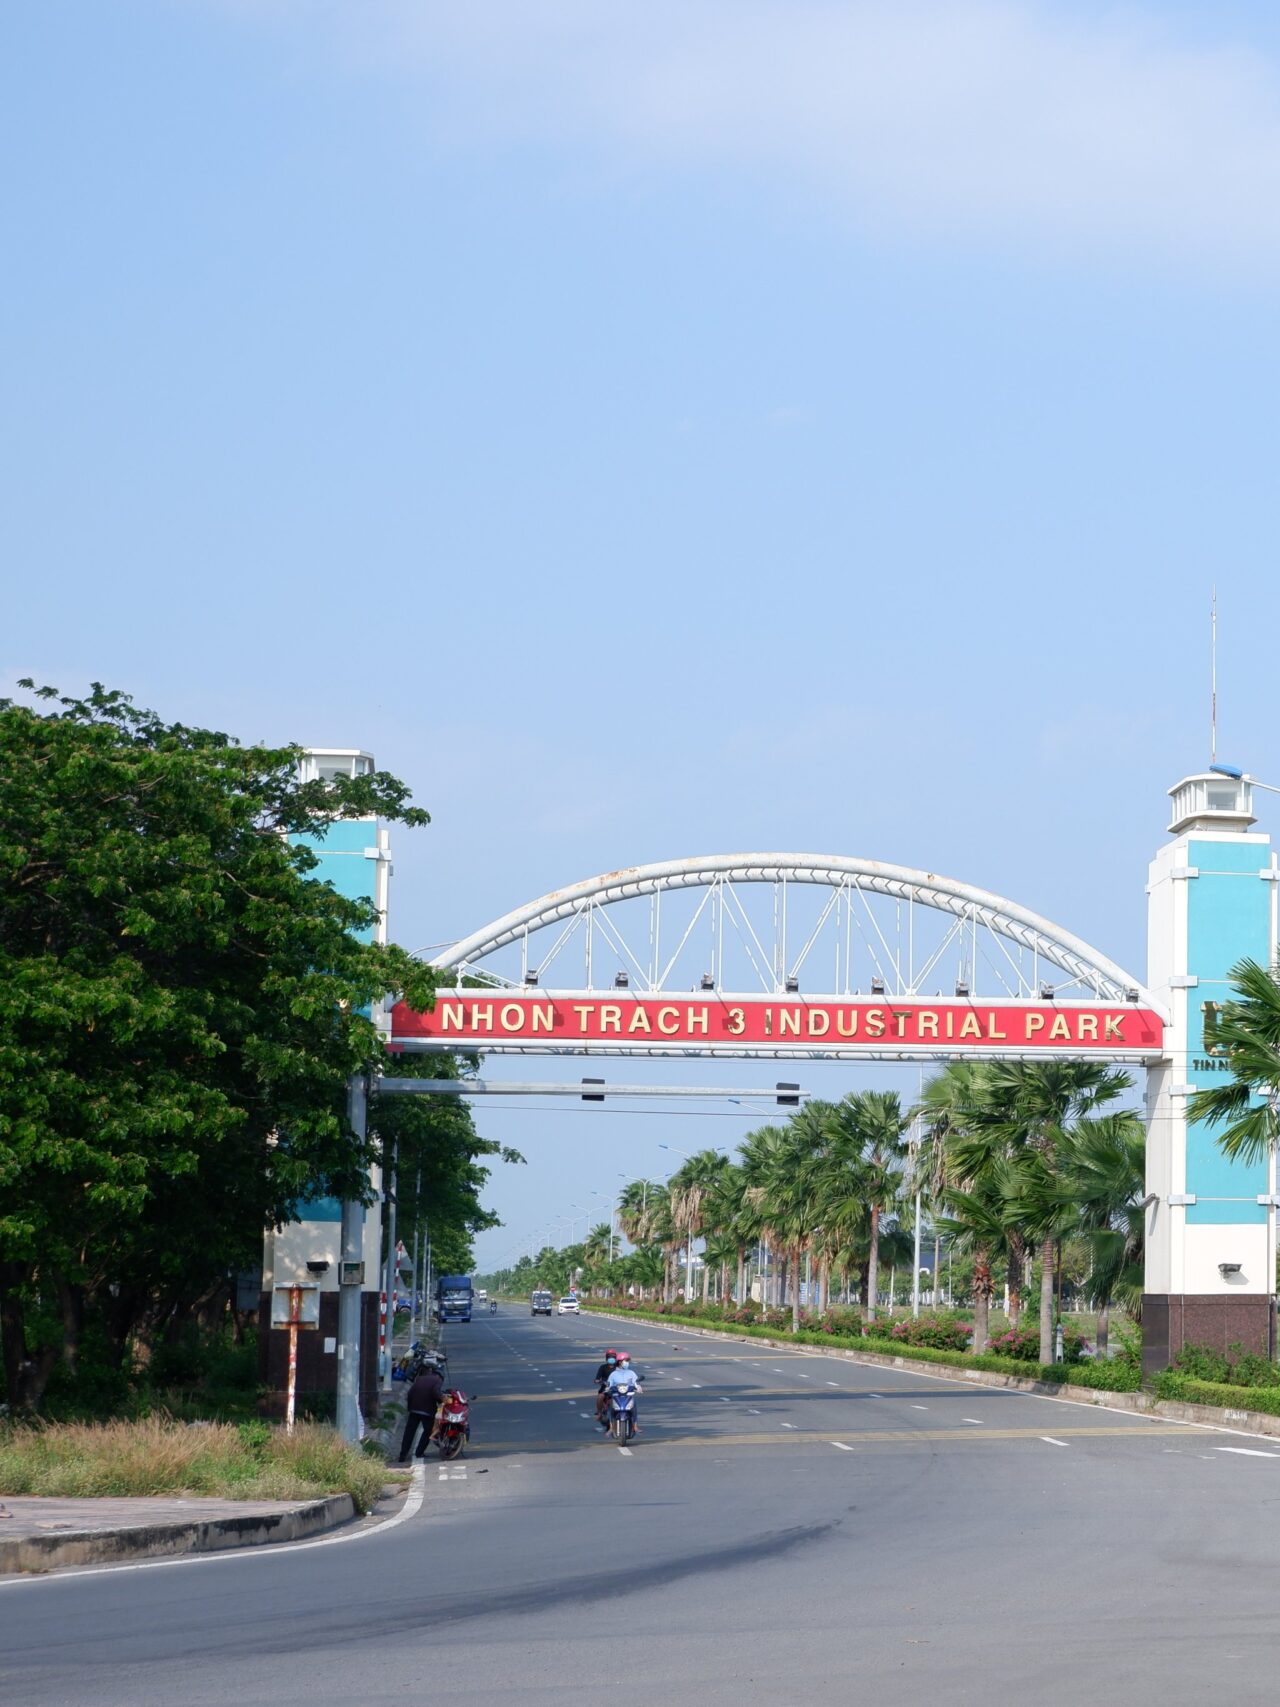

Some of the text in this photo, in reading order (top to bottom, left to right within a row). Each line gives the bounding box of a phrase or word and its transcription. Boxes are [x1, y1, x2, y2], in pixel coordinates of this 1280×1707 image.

[442, 1003, 1125, 1041] NHON TRACH 3 INDUSTRIAL PARK
